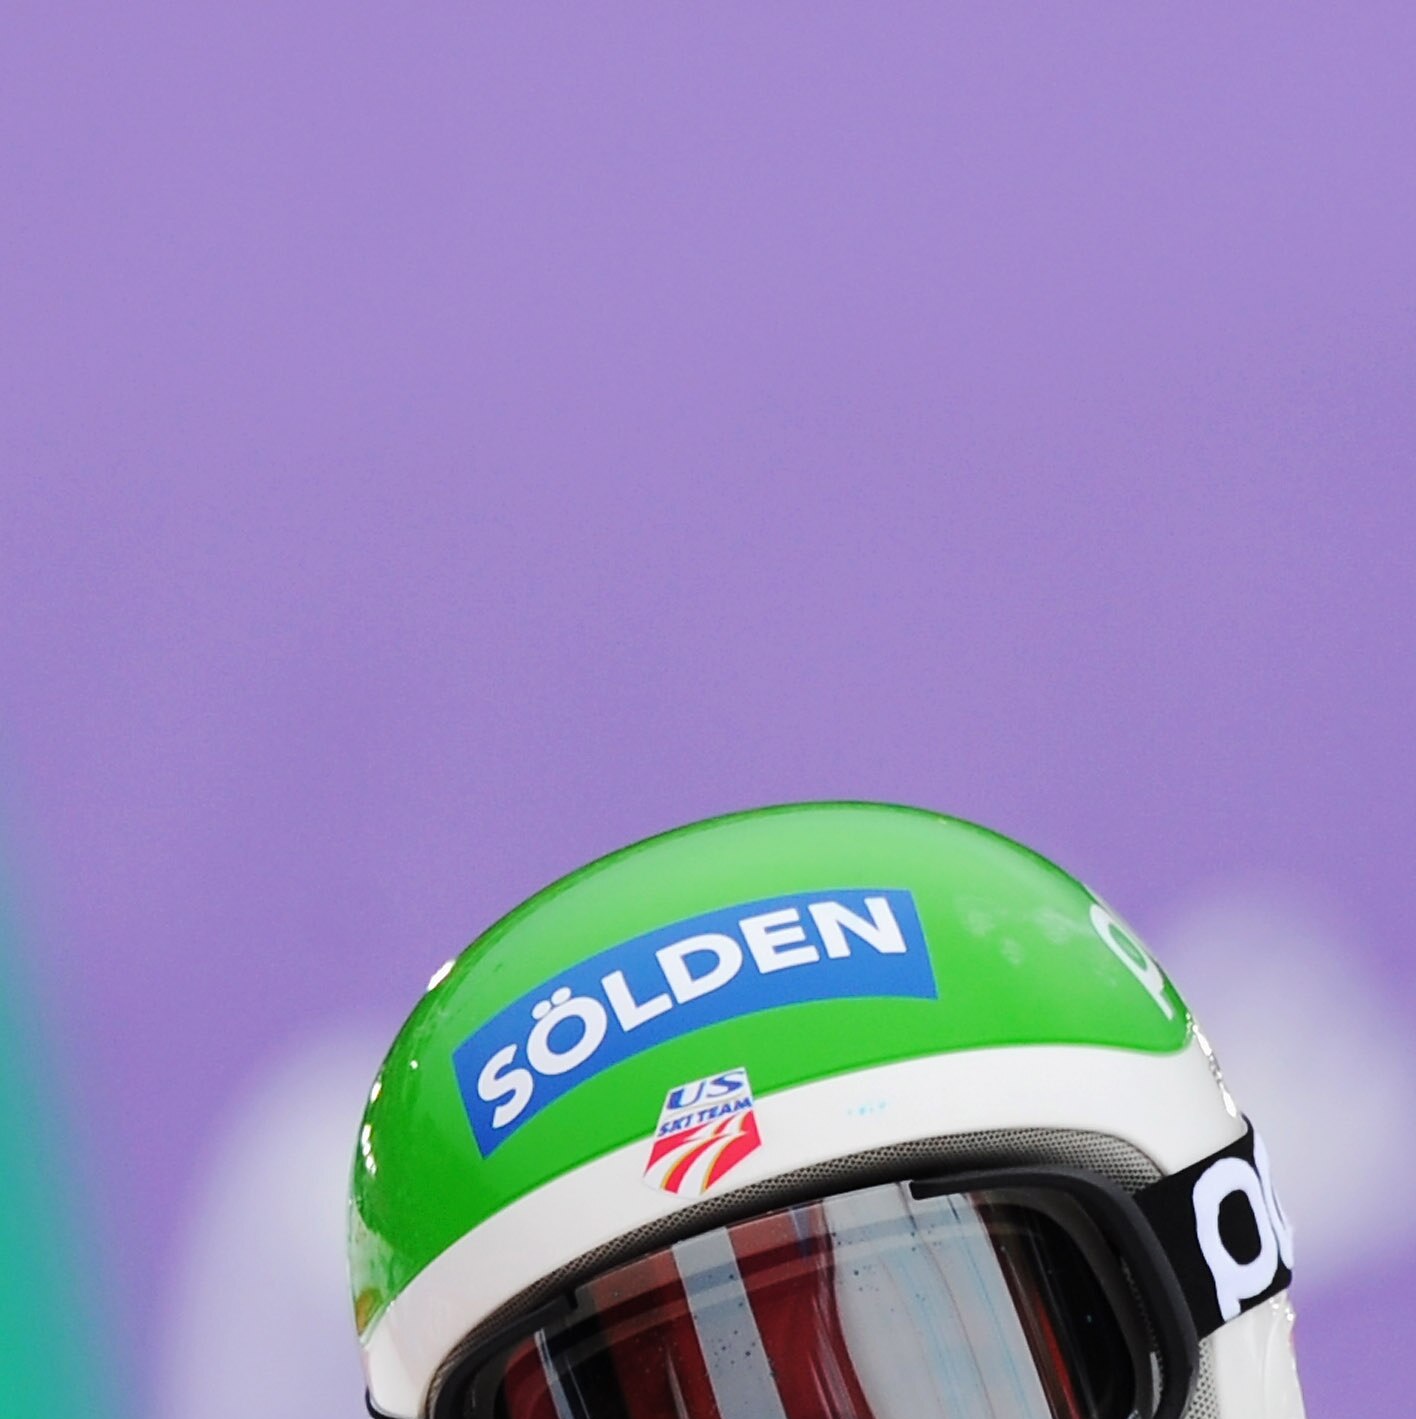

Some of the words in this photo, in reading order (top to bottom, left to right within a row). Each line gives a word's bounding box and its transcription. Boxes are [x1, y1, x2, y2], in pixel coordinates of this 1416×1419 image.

[476, 895, 908, 1129] SÖLDEN
[666, 1070, 745, 1110] US
[657, 1115, 692, 1137] SKI
[696, 1096, 752, 1123] TEAM
